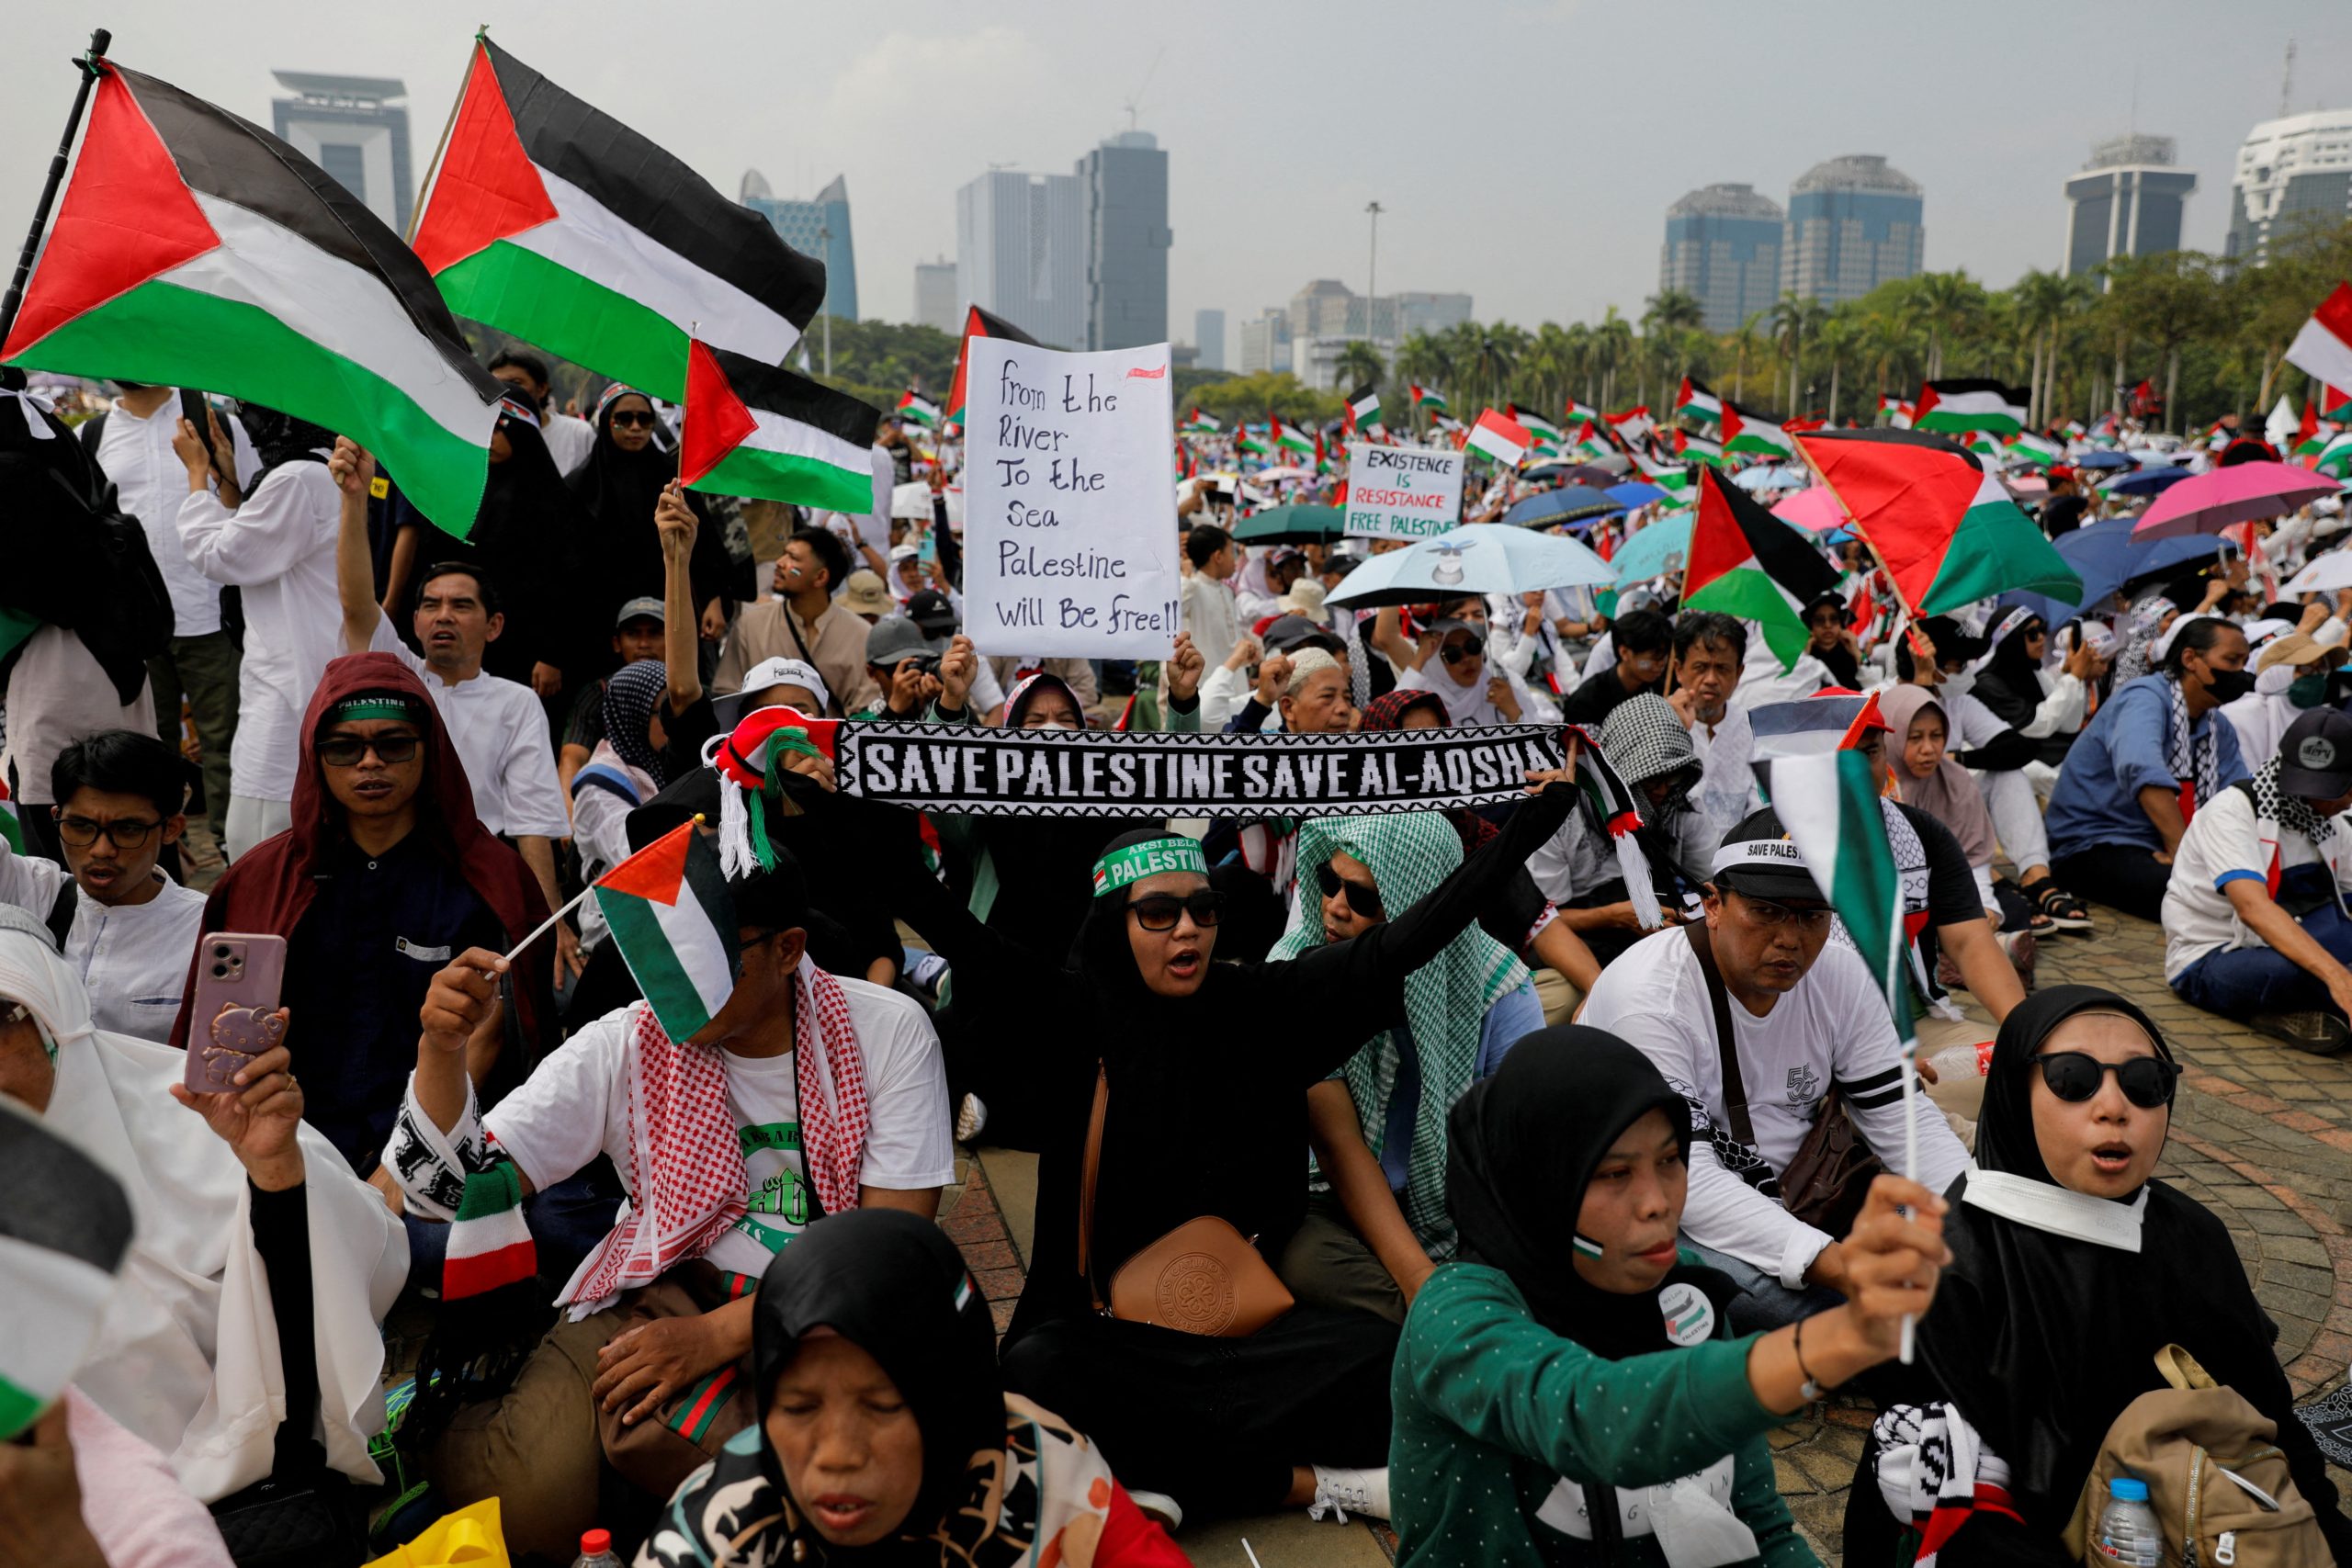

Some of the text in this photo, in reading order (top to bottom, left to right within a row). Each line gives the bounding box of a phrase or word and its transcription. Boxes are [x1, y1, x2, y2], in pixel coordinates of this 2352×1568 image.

[1001, 359, 1117, 412] from the
[999, 414, 1069, 451] River
[996, 457, 1105, 491] To the
[1367, 450, 1453, 474] EXISTENCE
[1396, 472, 1411, 488] IS
[1355, 487, 1445, 508] RESISTANCE
[1007, 500, 1059, 527] Sea
[1350, 512, 1382, 531] FREE
[999, 539, 1125, 579] Palestine
[1059, 597, 1098, 628] Be
[865, 739, 1555, 798] SAVE PALESTINE SAVE AL-AQSHA
[1128, 839, 1198, 855] AKSI BELA
[1747, 844, 1802, 859] SAVE PALES
[1170, 1258, 1219, 1276] CATINO
[1682, 1321, 1709, 1341] PALESTINE
